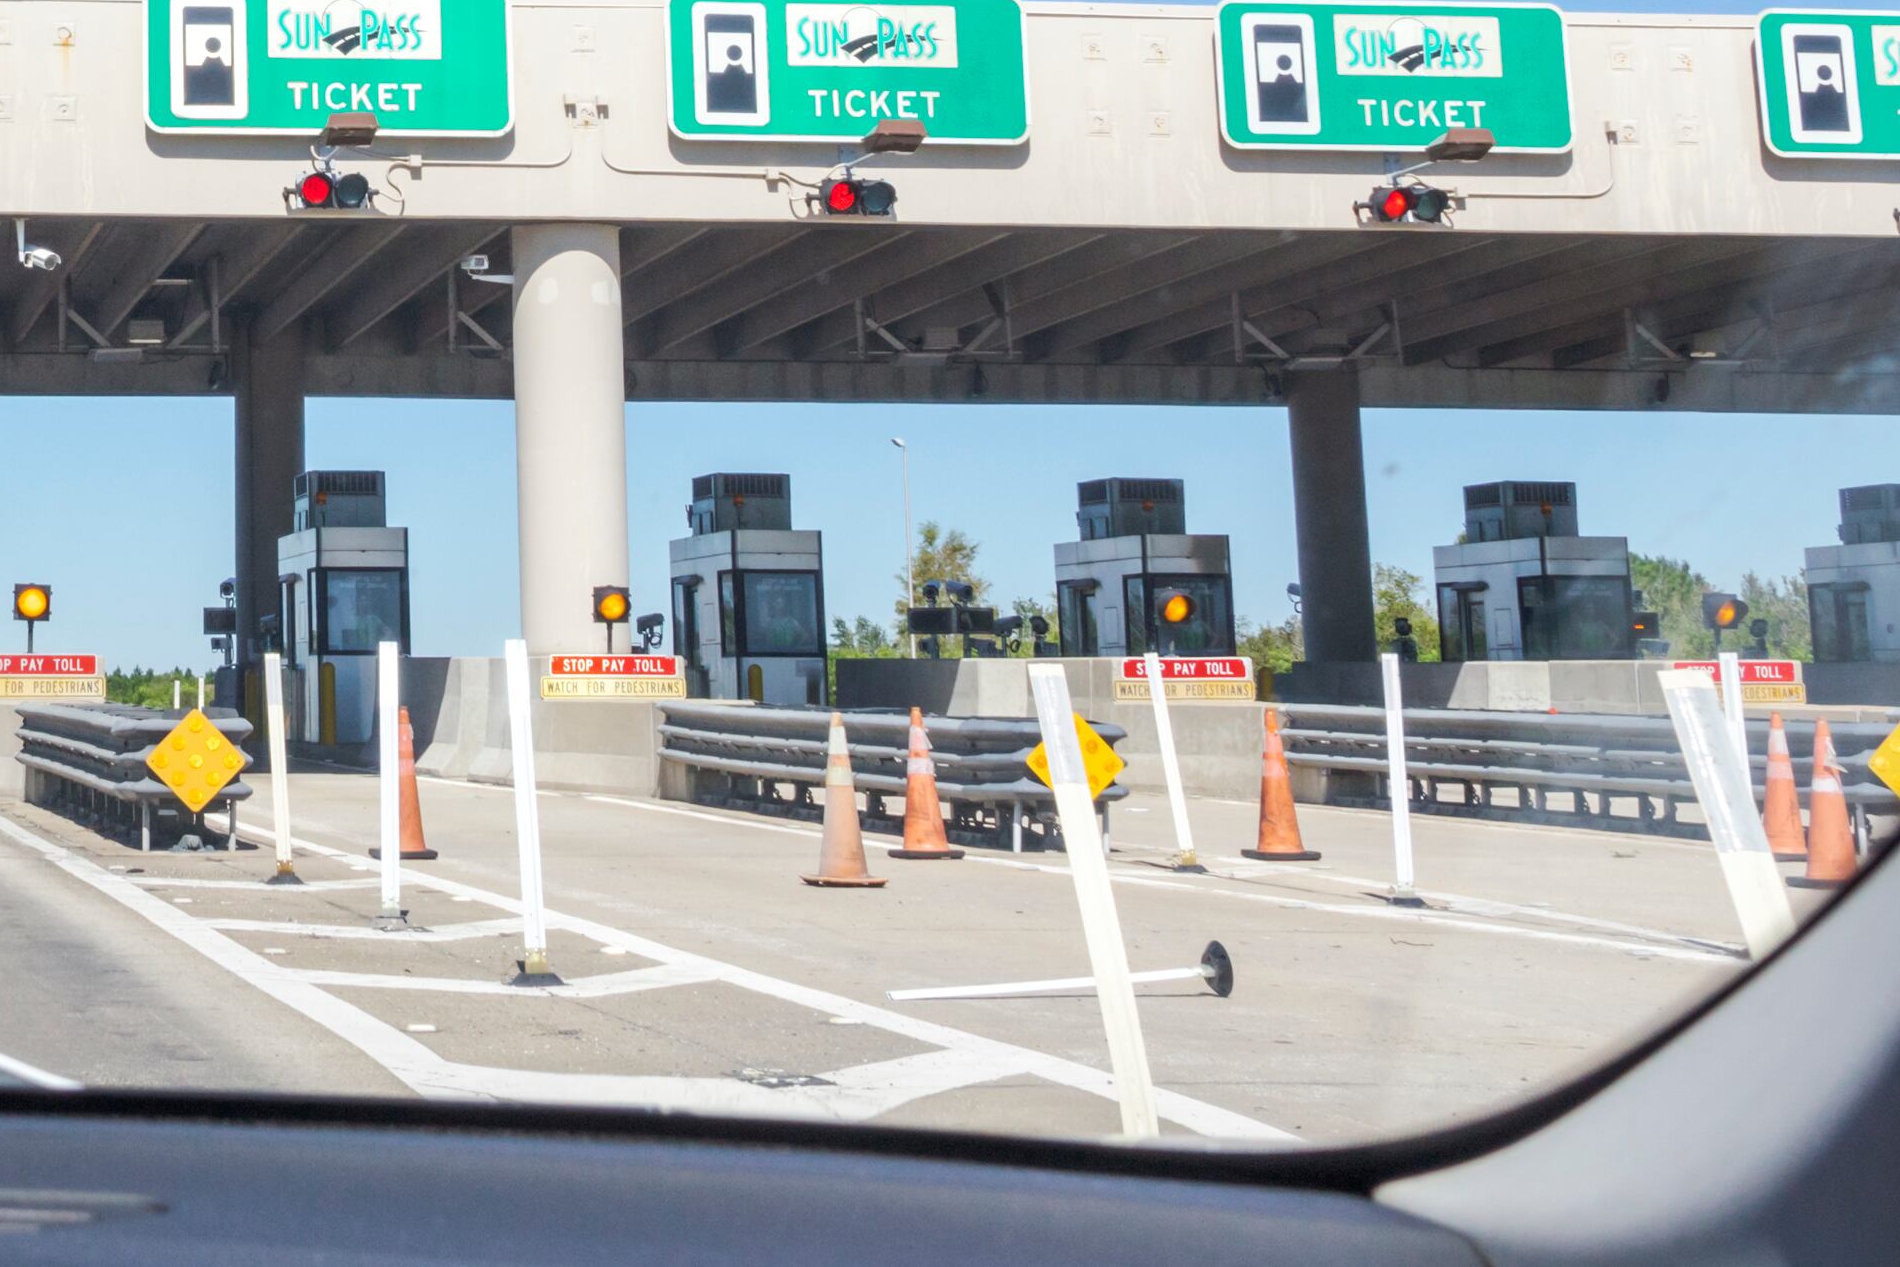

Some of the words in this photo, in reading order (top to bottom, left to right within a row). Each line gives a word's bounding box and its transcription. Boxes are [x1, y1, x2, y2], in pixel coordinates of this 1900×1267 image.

[278, 8, 332, 51] SUN
[360, 9, 422, 52] PASS
[797, 16, 849, 59] SUN
[877, 16, 939, 60] PASS
[1345, 26, 1397, 69] SUN
[1422, 27, 1485, 70] PASS
[287, 81, 422, 111] TICKET
[808, 89, 940, 119] TICKET
[1357, 99, 1486, 128] TICKET
[20, 658, 44, 671] PAY
[53, 658, 83, 671] TOLL
[563, 658, 593, 672] STOP
[602, 658, 625, 672] PAY
[635, 658, 664, 672] TOLL
[1174, 662, 1196, 675] PAY
[1205, 662, 1233, 675] TOLL
[1754, 666, 1783, 678] TOLL
[5, 681, 24, 693] FOR
[33, 681, 100, 693] PEDESTRIANS
[547, 681, 577, 693] WATCH
[588, 681, 605, 693] FOR
[614, 681, 680, 693] PEDESTRIANS
[1120, 683, 1150, 696] WATCH
[1166, 683, 1177, 696] OR
[1186, 683, 1249, 696] PEDESTRIANS
[1741, 687, 1800, 700] EDESTRIANS
